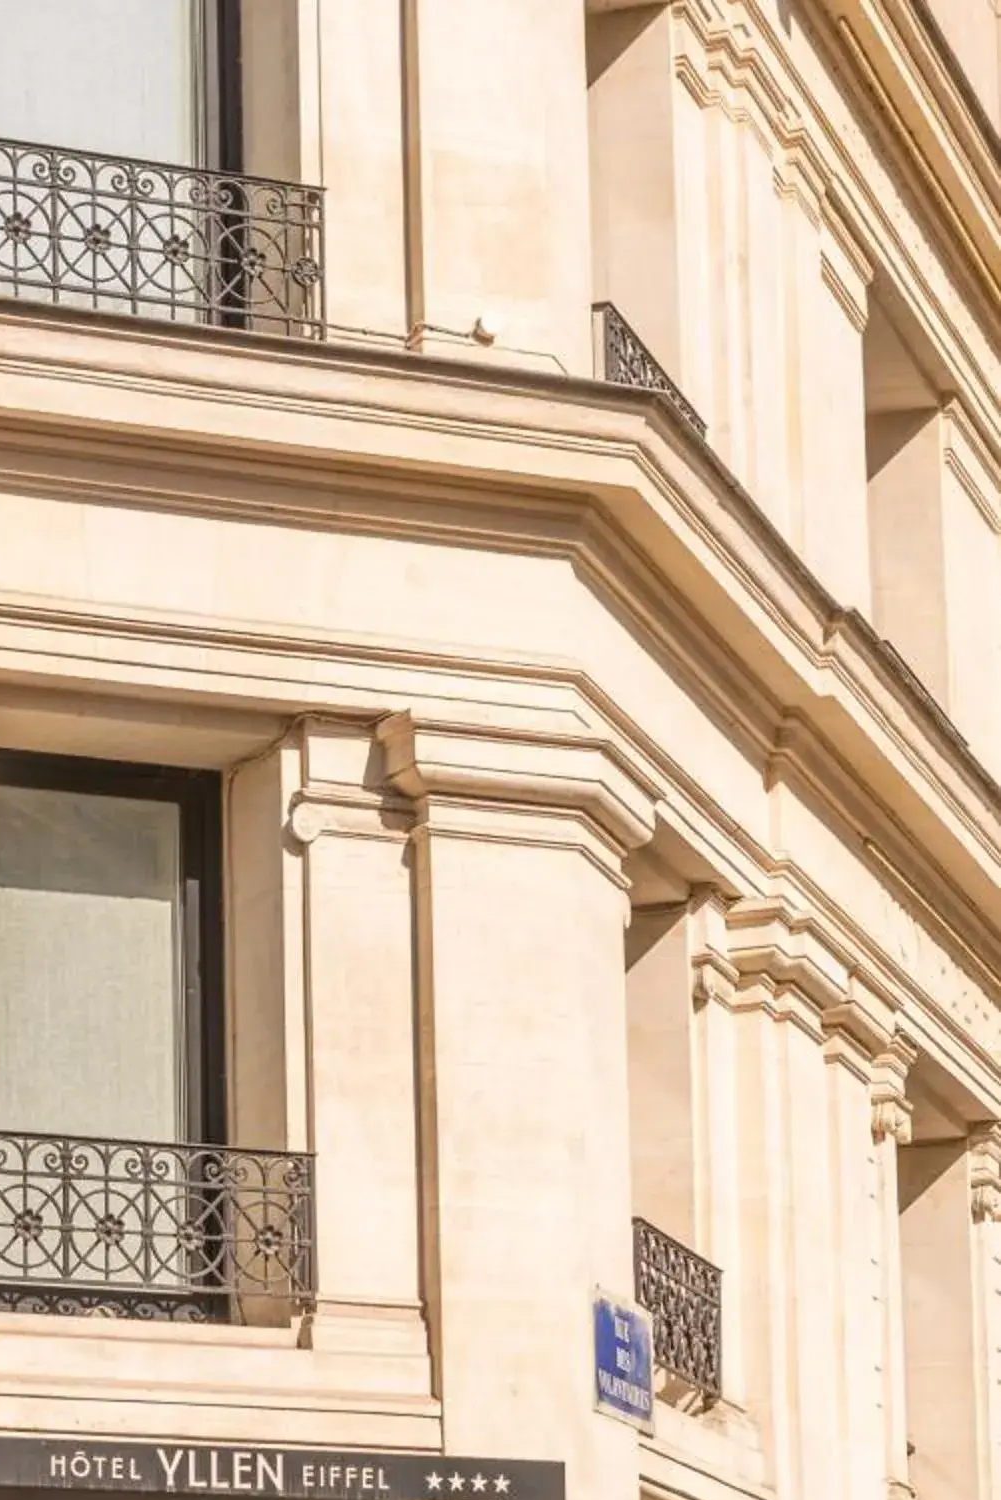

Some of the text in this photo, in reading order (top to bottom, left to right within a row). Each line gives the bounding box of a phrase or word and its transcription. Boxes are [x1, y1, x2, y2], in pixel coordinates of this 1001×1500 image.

[49, 1448, 391, 1491] HÔTEL YLLEN EIFFEL
